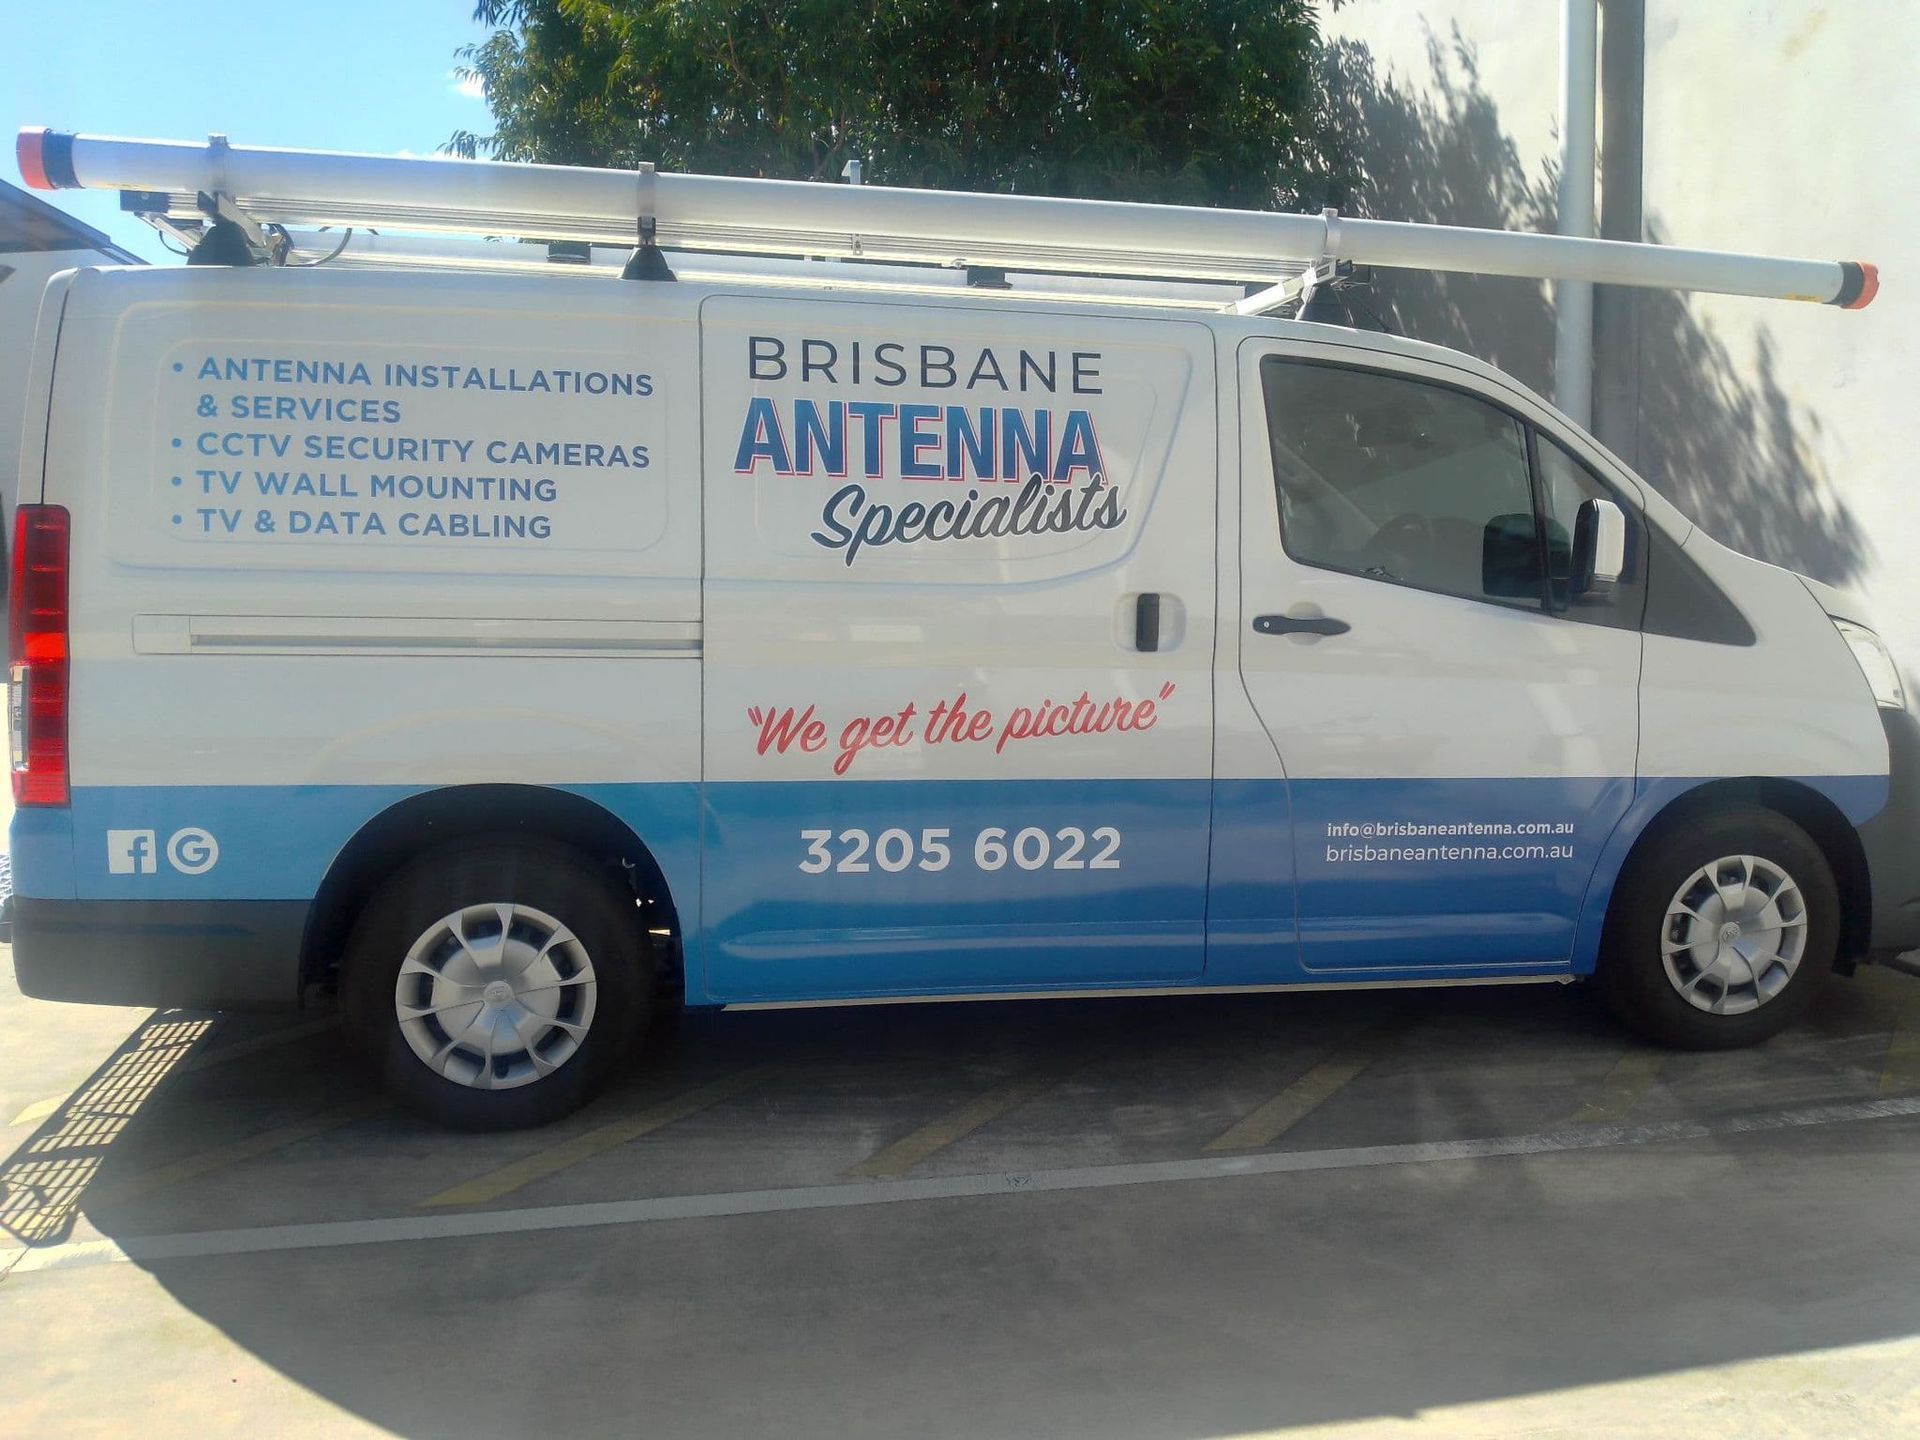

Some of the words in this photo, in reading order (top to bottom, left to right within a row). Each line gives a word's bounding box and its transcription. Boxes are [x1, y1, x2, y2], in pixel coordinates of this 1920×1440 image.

[198, 357, 372, 386] ANTENNA
[385, 364, 654, 397] INSTALLATIONS
[748, 335, 1104, 395] BRISBANE
[196, 393, 218, 418] &
[231, 395, 401, 424] SERVICES
[196, 432, 292, 458] CCTV
[303, 435, 474, 464] SECURITY
[486, 441, 651, 469] CAMERAS
[733, 396, 1109, 485] ANTENNA
[197, 470, 242, 494] TV
[254, 471, 358, 498] WALL
[371, 475, 558, 503] MOUNTING
[197, 509, 242, 533] TV
[254, 510, 276, 534] &
[290, 511, 386, 537] DATA
[399, 513, 552, 539] CABLING
[811, 472, 1127, 567] Specialists
[833, 702, 916, 776] get
[924, 692, 994, 745] the
[1327, 822, 1575, 838] info@brisbaneantenna.com.au
[798, 828, 951, 875] 3205
[974, 827, 1122, 871] 6022
[1326, 844, 1574, 863] brisbaneantenna.com.au
